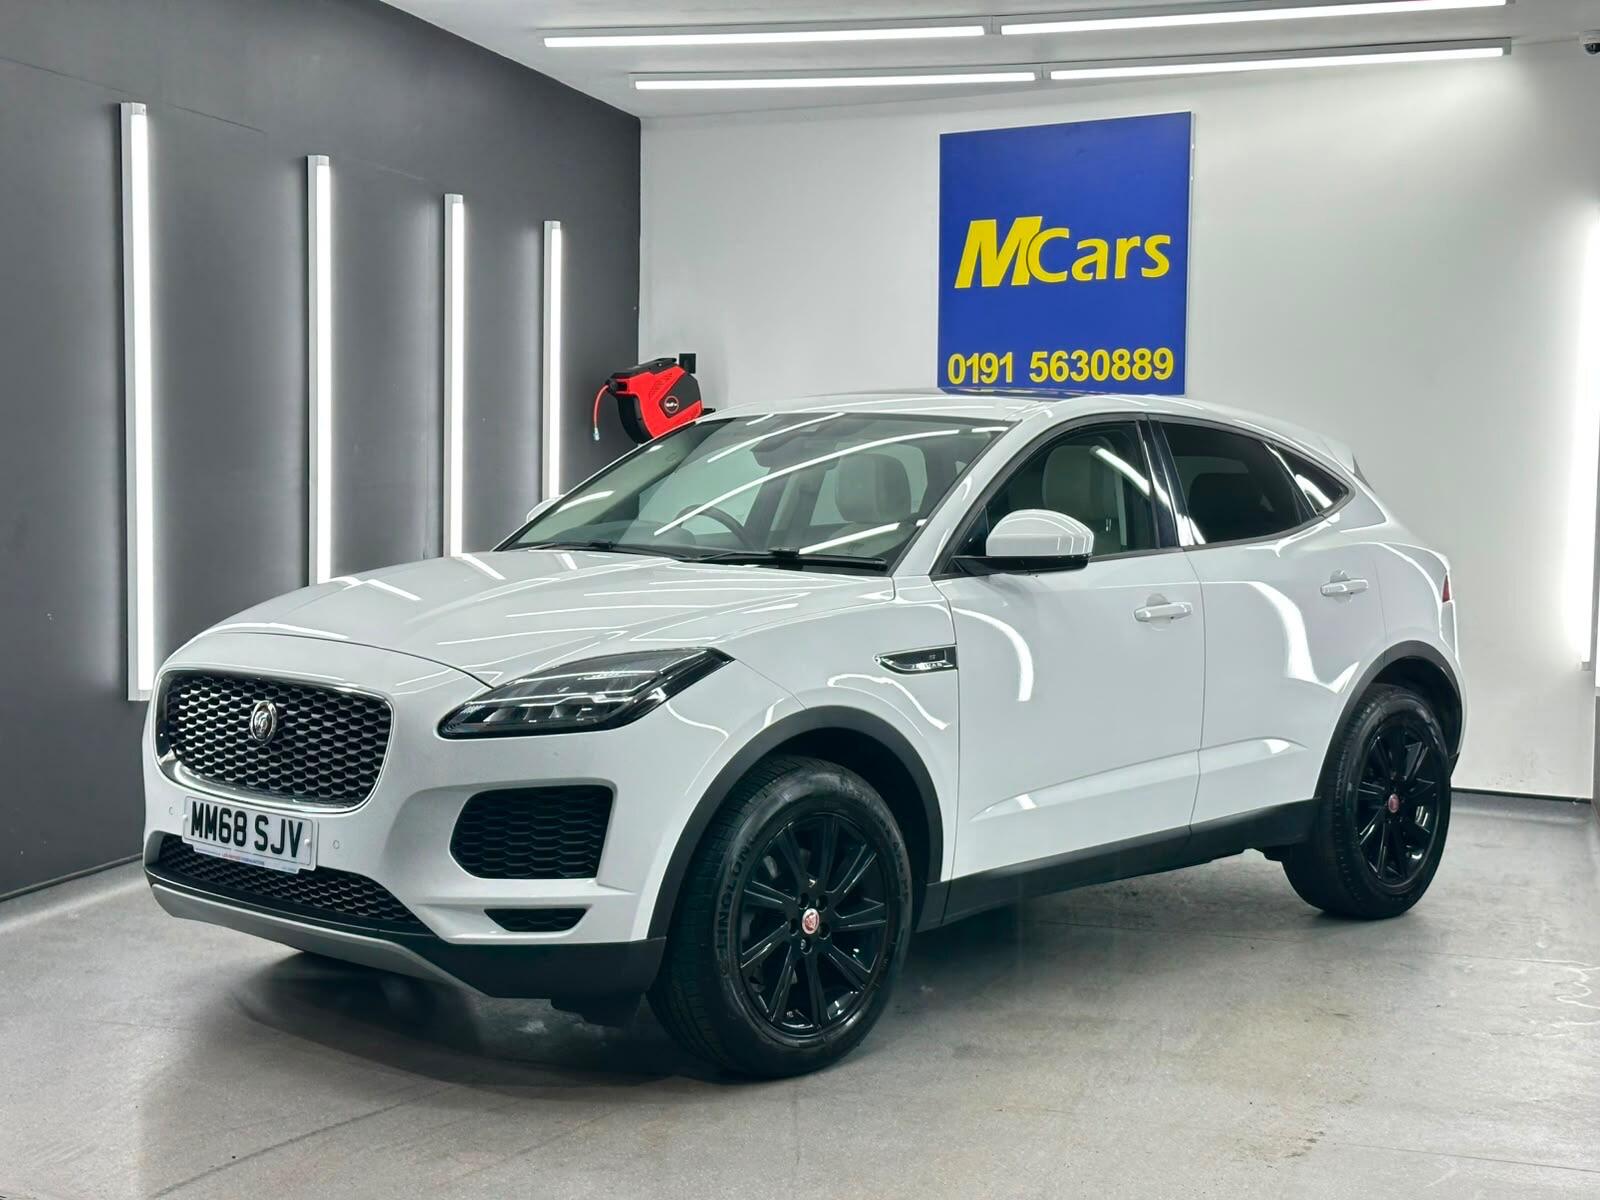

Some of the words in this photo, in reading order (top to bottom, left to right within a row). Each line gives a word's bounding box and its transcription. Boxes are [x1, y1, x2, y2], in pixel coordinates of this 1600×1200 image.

[947, 351, 1013, 384] 0191
[1029, 347, 1174, 382] 5630889
[191, 801, 247, 847] MM68
[254, 815, 303, 858] SJV
